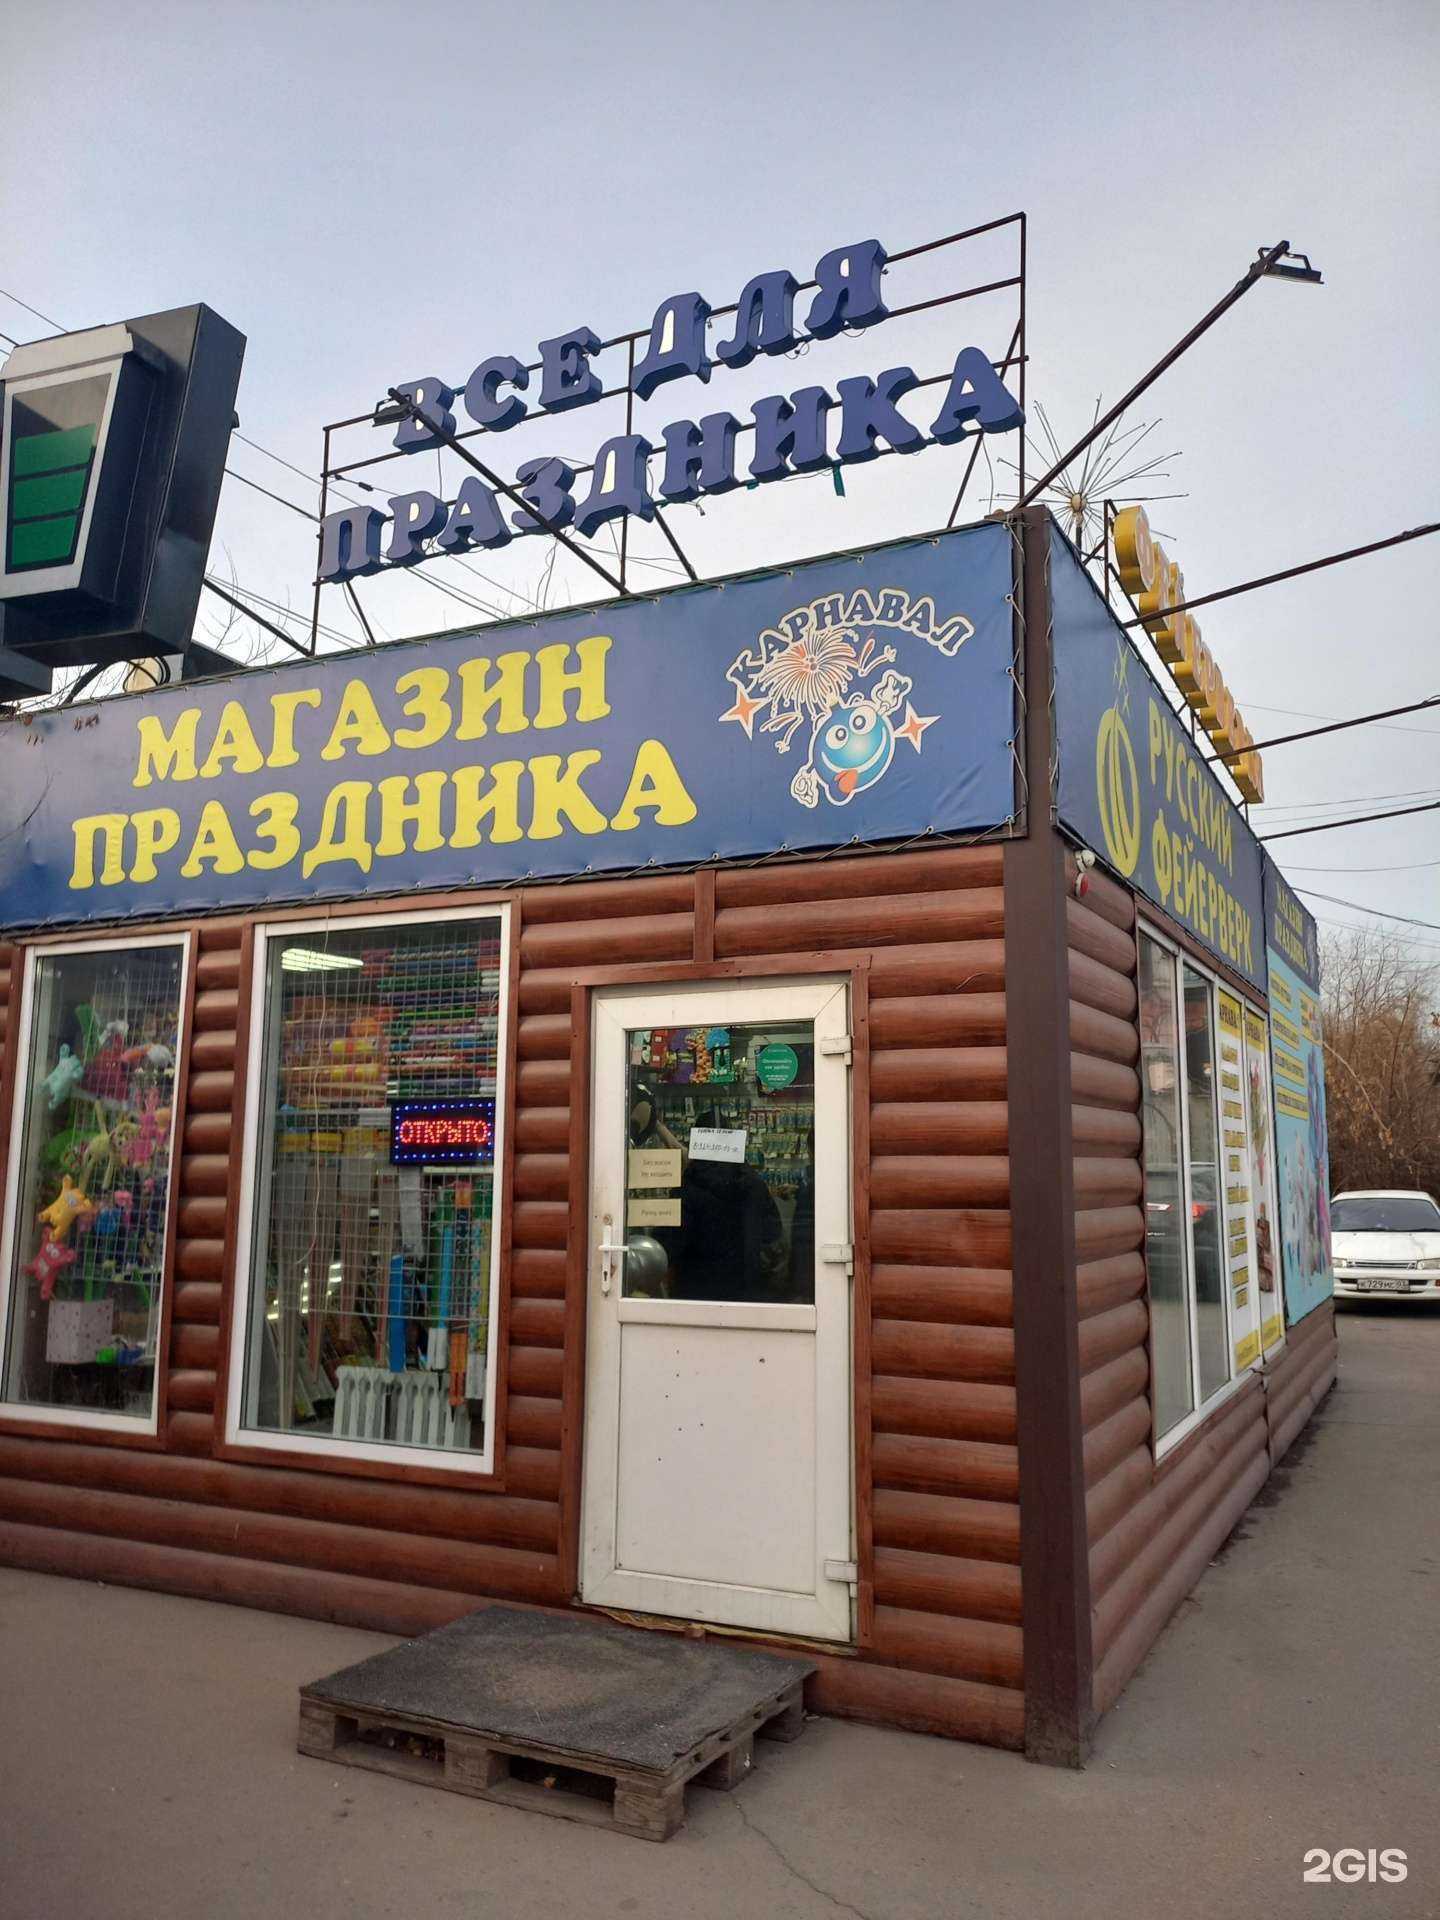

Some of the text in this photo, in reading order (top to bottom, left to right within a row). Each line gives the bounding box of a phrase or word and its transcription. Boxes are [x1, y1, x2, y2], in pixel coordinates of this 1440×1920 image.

[393, 239, 889, 455] ВСЕ ДЛЯ
[319, 346, 1026, 585] ПРАЗДНИКА
[132, 635, 613, 788] МАГАЗИН
[726, 588, 975, 693] КАРНАВАЛ
[68, 739, 698, 890] ПРАЗДНИКА
[1149, 696, 1232, 877] РУССКИЙ
[1152, 807, 1253, 974] ФЕЙЕРВЕРК
[399, 1119, 488, 1144] ОТКРЫТО
